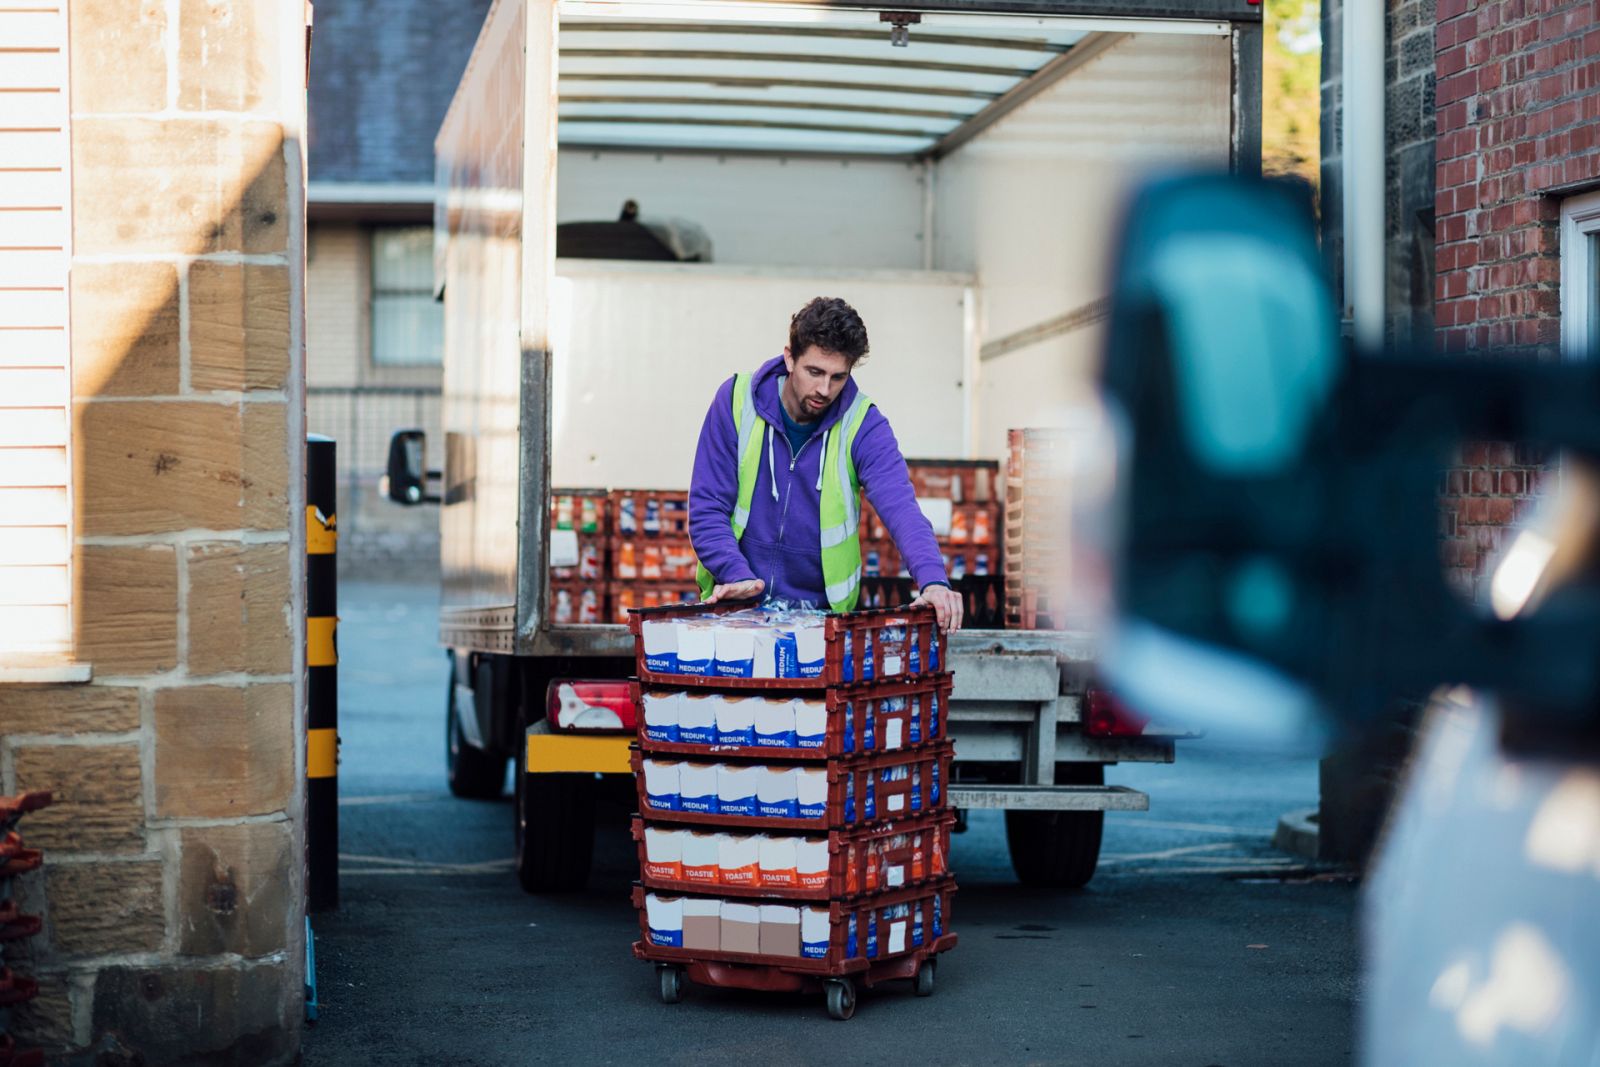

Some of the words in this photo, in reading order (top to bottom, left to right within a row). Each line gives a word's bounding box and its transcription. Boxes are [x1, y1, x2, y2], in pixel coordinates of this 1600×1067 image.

[679, 664, 705, 673] MEDIUM
[717, 665, 744, 674] MEDIUM
[680, 731, 706, 740] MEDIUM
[719, 735, 746, 743] MEDIUM
[757, 738, 785, 747] MEDIUM
[682, 801, 709, 810] MEDIUM
[720, 804, 748, 813] MEDIUM
[760, 806, 788, 815] MEDIUM
[649, 865, 675, 875] TOASTIE
[685, 870, 714, 878] TOASTIE
[724, 872, 753, 881] TOASTIE
[763, 874, 791, 882] TOASTIE
[802, 877, 827, 885] TOAST
[804, 946, 827, 954] MEDIU
